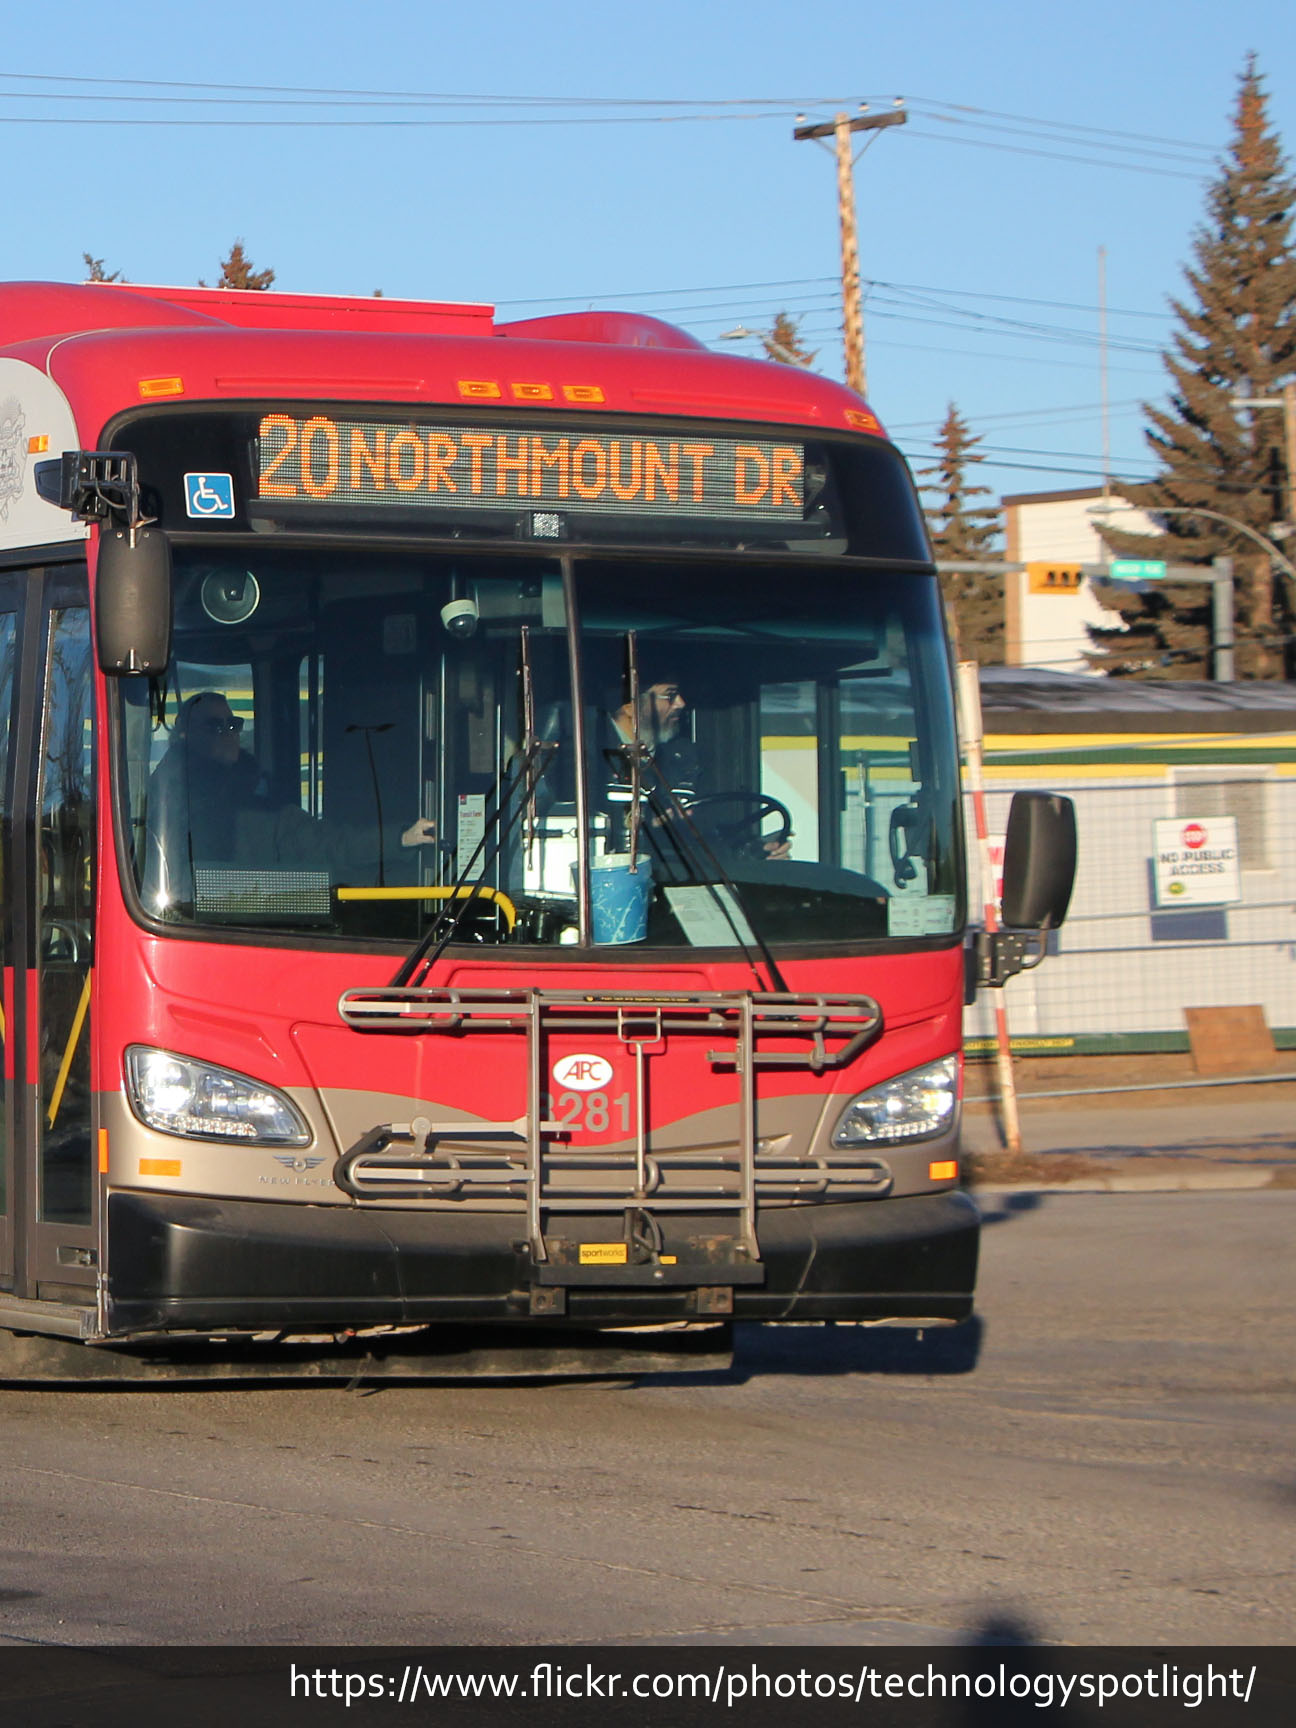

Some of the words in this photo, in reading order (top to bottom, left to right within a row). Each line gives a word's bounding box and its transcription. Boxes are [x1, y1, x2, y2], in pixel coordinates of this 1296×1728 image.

[258, 414, 338, 498] 20
[350, 429, 715, 503] NORTHMOUNT
[734, 446, 803, 507] DR
[1160, 851, 1179, 863] NO
[1183, 848, 1234, 861] PUBLIC
[1171, 862, 1226, 875] ACCESS
[581, 1249, 625, 1258] sportworks
